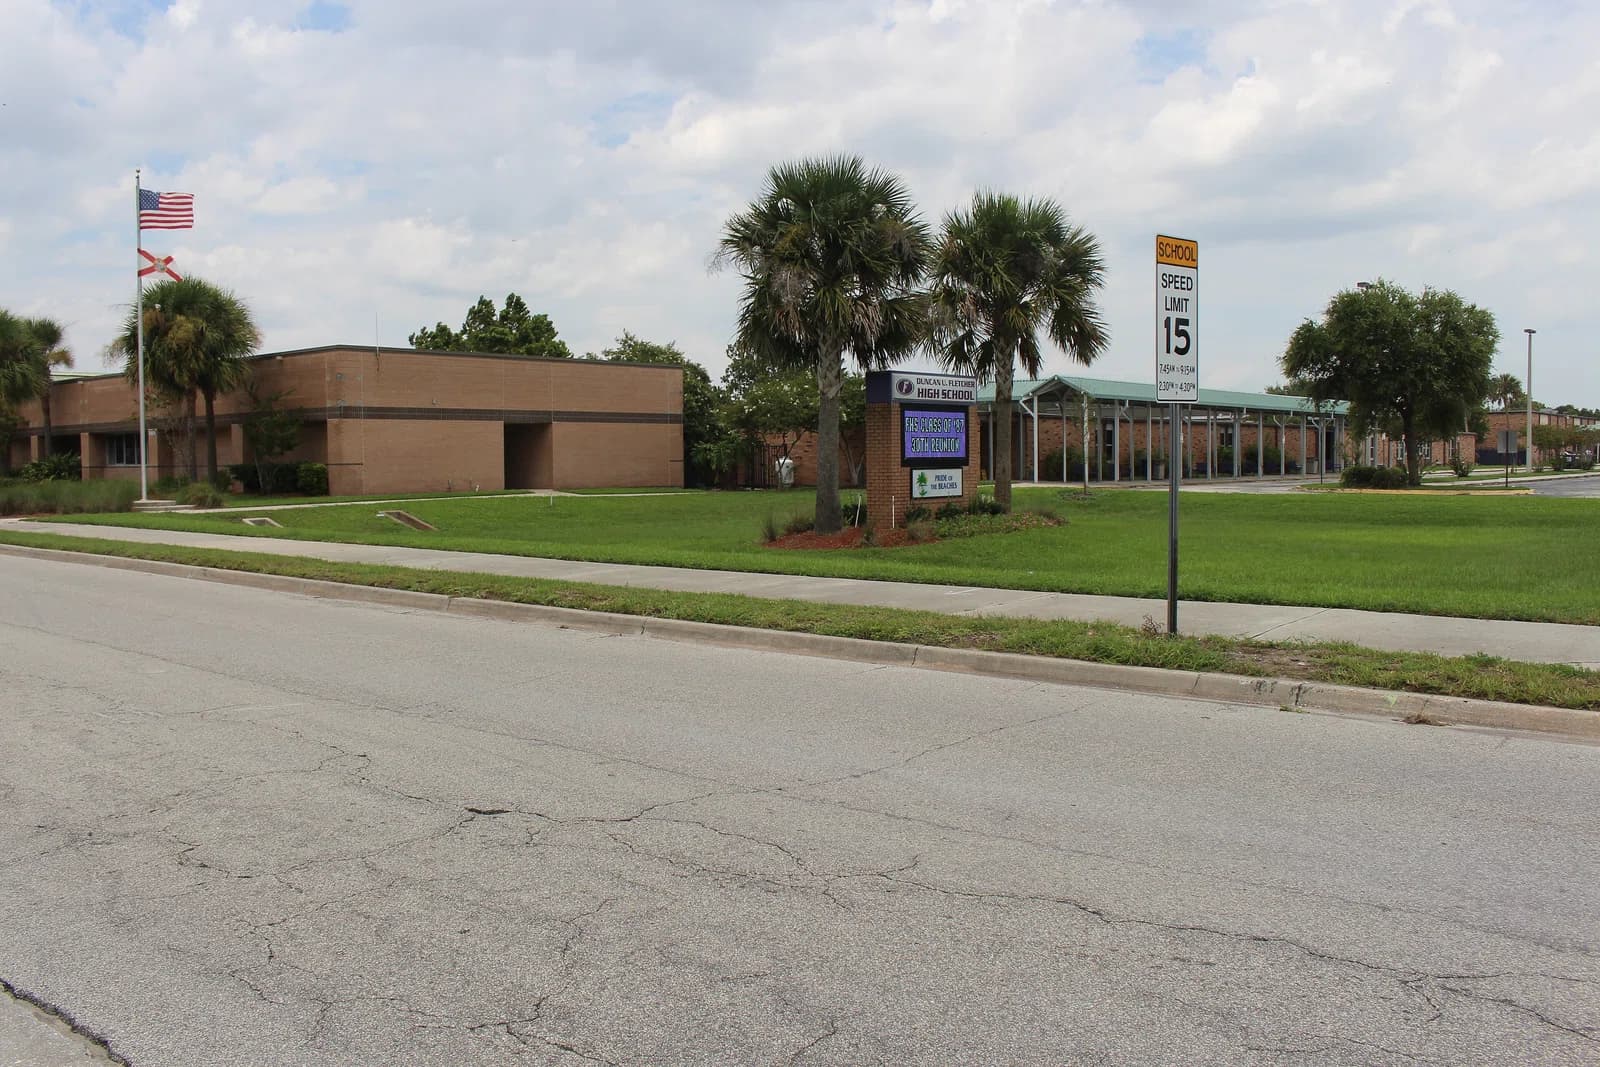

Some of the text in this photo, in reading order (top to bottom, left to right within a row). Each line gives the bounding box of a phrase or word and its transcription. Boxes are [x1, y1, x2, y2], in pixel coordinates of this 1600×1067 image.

[1159, 242, 1195, 261] SCHOOL
[1161, 273, 1193, 290] SPEED
[1165, 296, 1189, 312] LIMIT
[1164, 316, 1191, 355] 15
[917, 378, 941, 386] DUNCAN
[949, 380, 975, 388] FLETCHER
[917, 388, 975, 400] HIGH SCHOOL
[905, 417, 919, 432] FHS
[921, 418, 942, 432] CLASS
[944, 418, 952, 433] OF
[931, 438, 960, 452] REUNION
[935, 474, 947, 482] PRIDE
[938, 482, 957, 490] BEACHES
